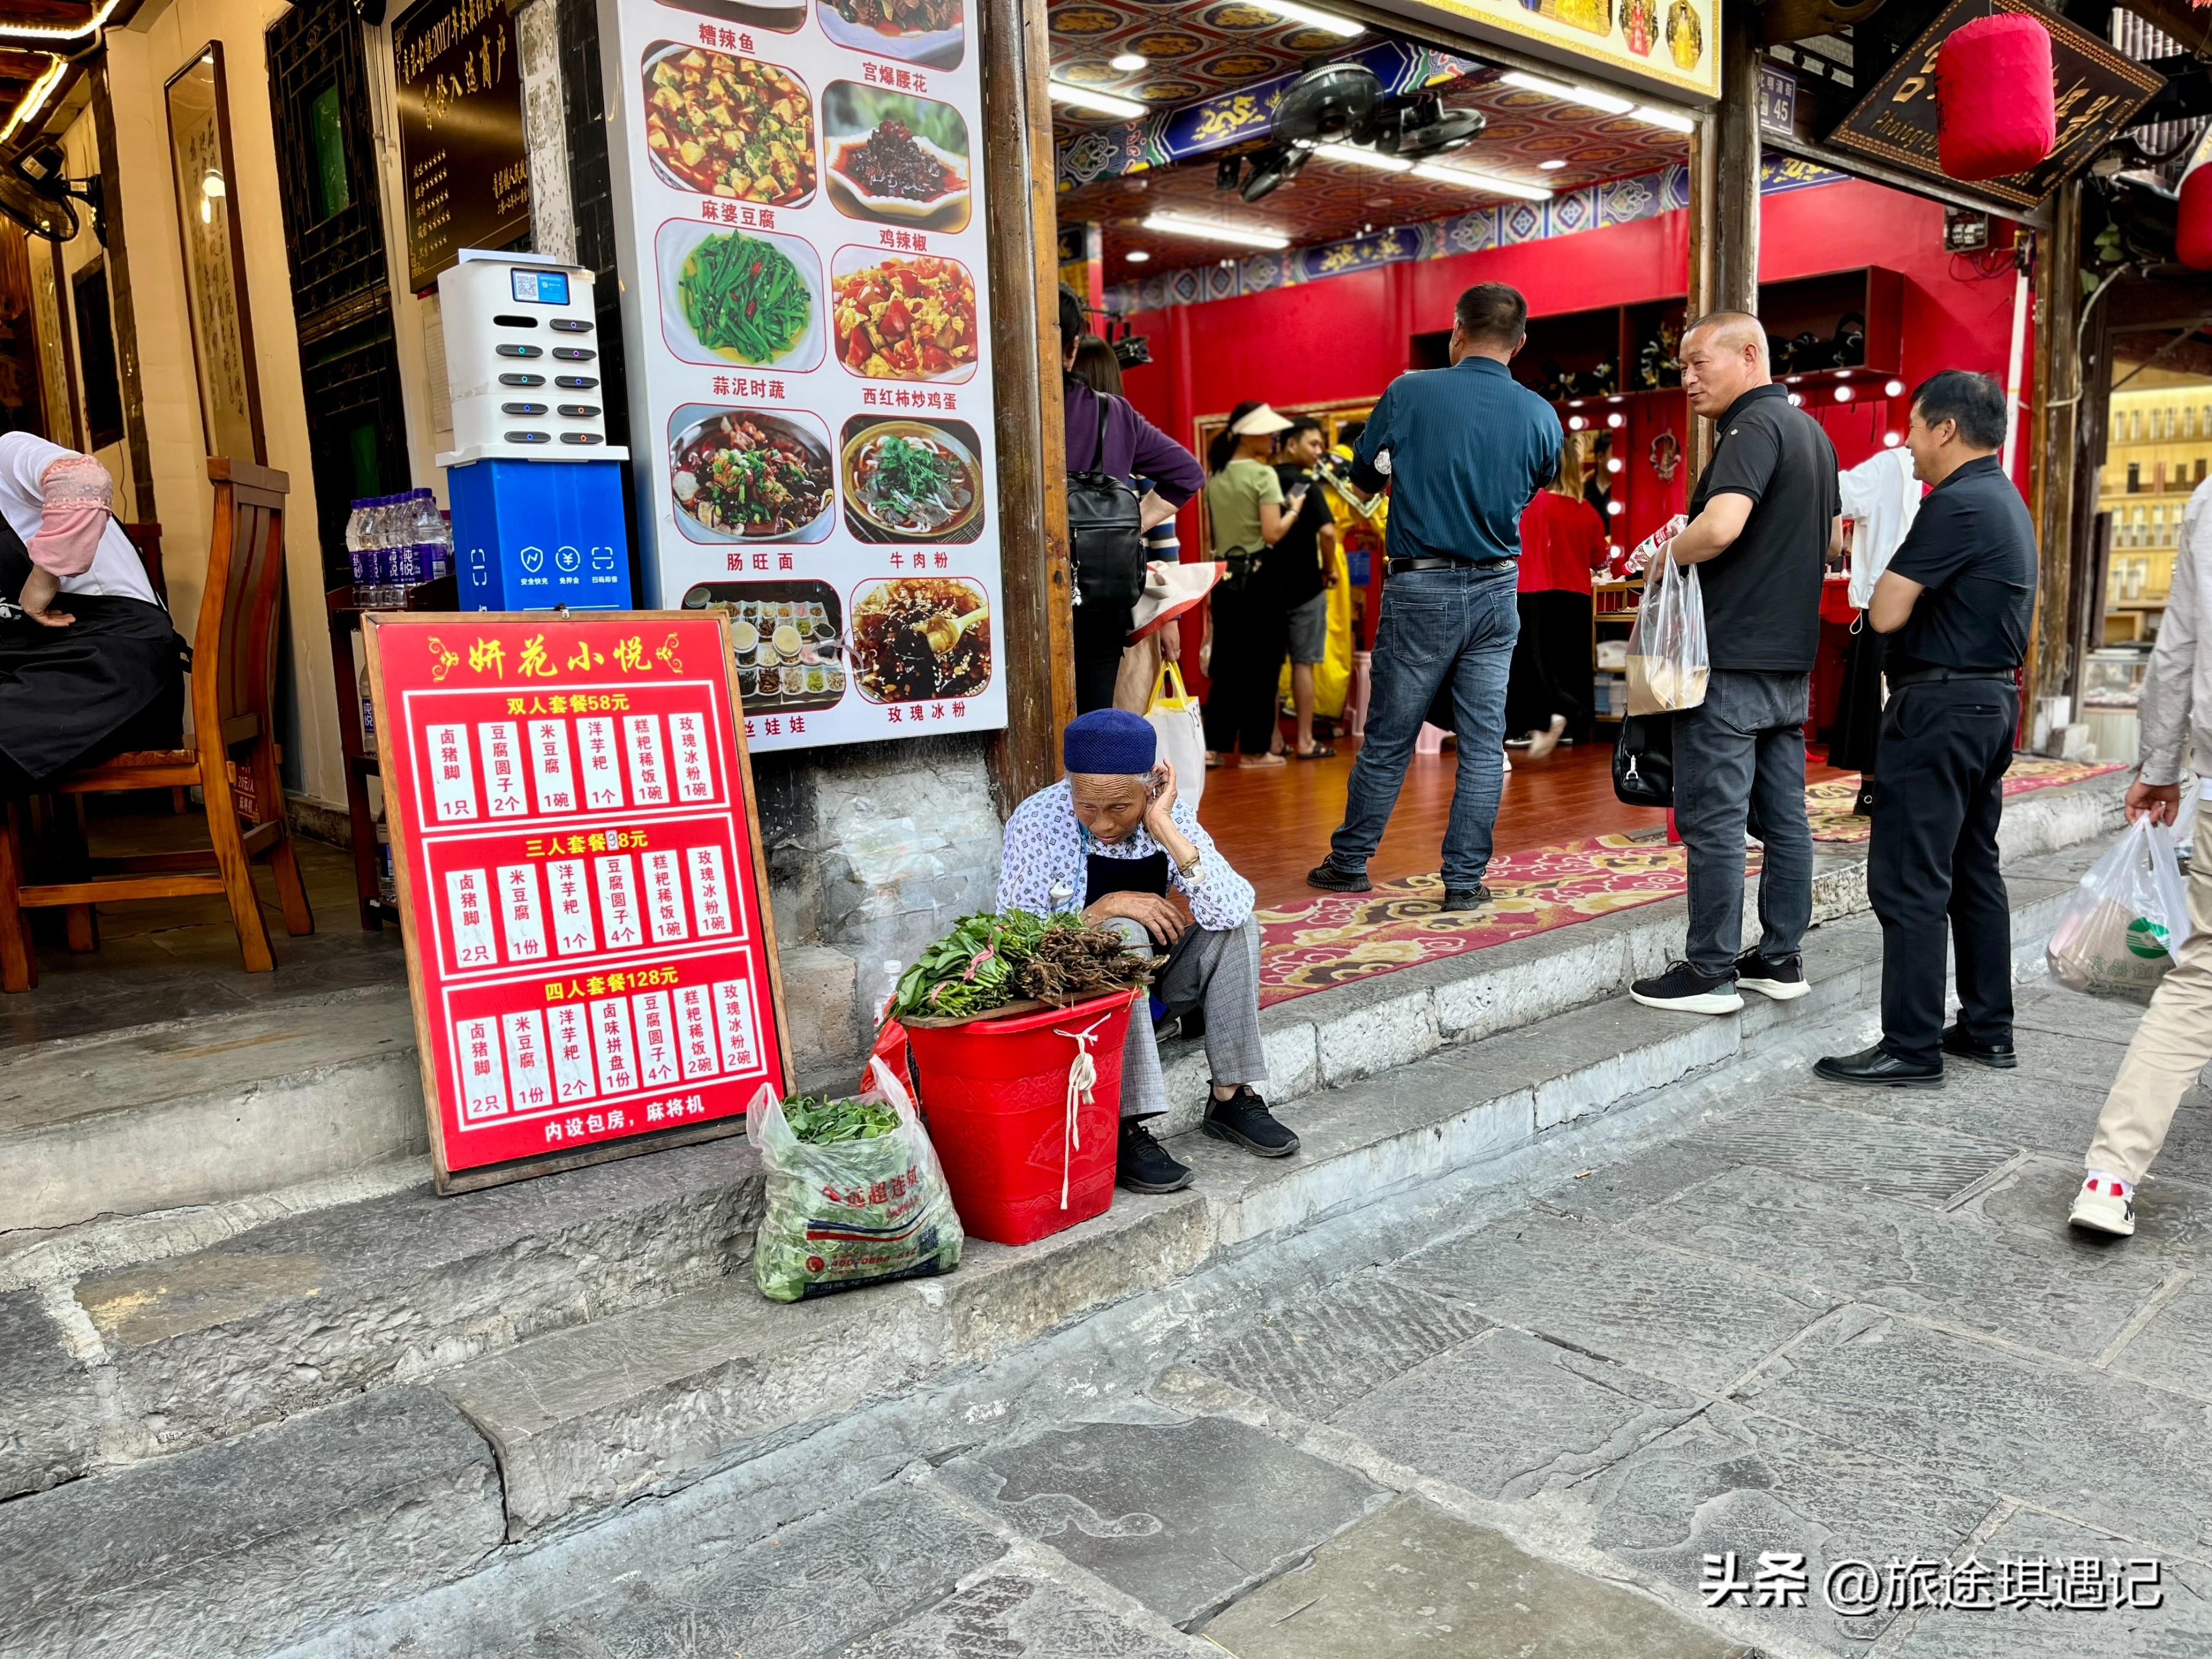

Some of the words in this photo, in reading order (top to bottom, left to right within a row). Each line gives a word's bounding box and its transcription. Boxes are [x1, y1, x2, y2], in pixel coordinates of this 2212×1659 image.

[699, 23, 755, 54] 糟辣鱼
[863, 62, 927, 93] 宫爆腰花
[1774, 99, 1788, 121] 45
[1870, 109, 1939, 156] Photograp
[702, 200, 775, 229] 麻婆豆腐
[880, 230, 927, 252] 鸡辣椒
[713, 376, 785, 399] 蒜泥时蔬
[863, 388, 957, 411] 西红柿炒鸡蛋
[727, 552, 793, 571] 肠旺面
[890, 552, 948, 569] 牛肉粉
[469, 634, 653, 679] 妍花小悦
[506, 693, 630, 715] 双人套餐58元
[889, 702, 965, 722] 玫瑰冰粉
[440, 728, 461, 780] 卤猪脚
[541, 724, 560, 774] 米豆腐
[588, 721, 608, 770] 洋芋粑
[631, 718, 656, 785] 糕粑稀饭
[679, 718, 701, 779] 玫瑰冰粉
[491, 725, 514, 793] 豆腐圆子
[544, 792, 570, 808] 1碗
[592, 789, 616, 803] 1个
[639, 785, 663, 800] 1碗
[684, 782, 708, 796] 1碗
[444, 799, 470, 815] 1只
[494, 796, 520, 812] 2个
[558, 864, 580, 914] 洋芋粑
[607, 858, 628, 925] 豆腐圆子
[652, 855, 674, 919] 糕粑稀饭
[697, 851, 719, 915] 玫瑰冰粉
[459, 873, 480, 927] 卤猪脚
[511, 870, 530, 921] 米豆腐
[658, 921, 682, 937] 1碗
[703, 915, 726, 930] 1碗
[563, 932, 587, 949] 1个
[611, 927, 635, 943] 4个
[462, 944, 489, 962] 2只
[514, 940, 539, 956] 1份
[545, 966, 679, 1001] 四人套餐128元
[684, 990, 706, 1056] 糕粑稀饭
[724, 985, 745, 1048] 玫瑰冰粉
[559, 1009, 580, 1061] 洋芋粑
[603, 1002, 625, 1071] 卤味拼盘
[644, 995, 666, 1062] 豆腐圆子
[470, 1022, 491, 1077] 卤猪脚
[515, 1016, 535, 1069] 米豆腐
[688, 1056, 715, 1075] 2碗
[728, 1050, 752, 1067] 2碗
[606, 1071, 631, 1089] 1份
[648, 1065, 673, 1081] 4个
[519, 1086, 545, 1104] 1份
[562, 1079, 588, 1097] 2个
[473, 1095, 500, 1113] 2只
